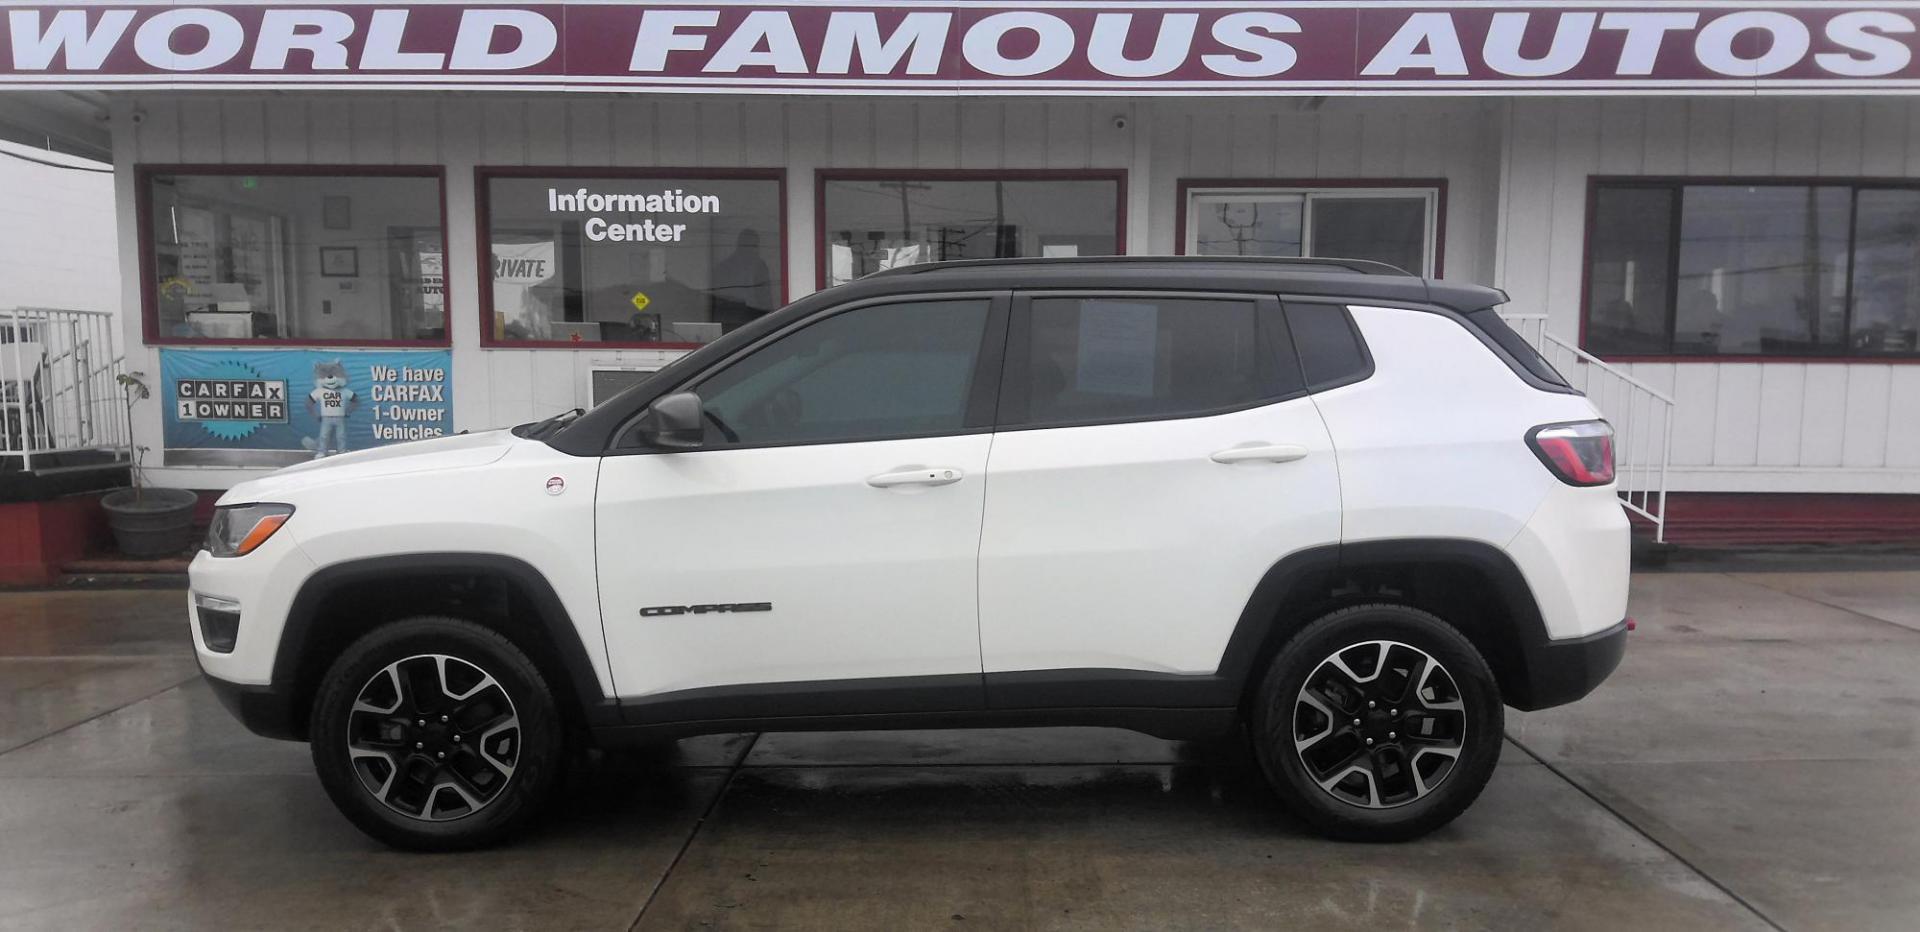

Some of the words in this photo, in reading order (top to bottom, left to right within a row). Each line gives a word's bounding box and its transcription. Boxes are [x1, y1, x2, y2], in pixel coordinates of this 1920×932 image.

[8, 8, 558, 72] WORLD
[628, 9, 1303, 77] FAMOUS
[1359, 10, 1917, 77] AUTOS
[548, 188, 720, 213] Information
[585, 217, 687, 242] Center
[495, 258, 546, 278] RIVATE
[370, 365, 398, 382] We
[402, 366, 444, 382] have
[178, 382, 281, 400] CARFAX
[322, 392, 342, 400] CAR
[370, 384, 444, 402] CARFAX
[182, 403, 193, 416] 1
[199, 404, 281, 418] OWNER
[324, 400, 342, 408] FOX
[372, 404, 445, 421] 1-Owner
[372, 423, 443, 440] Vehicles
